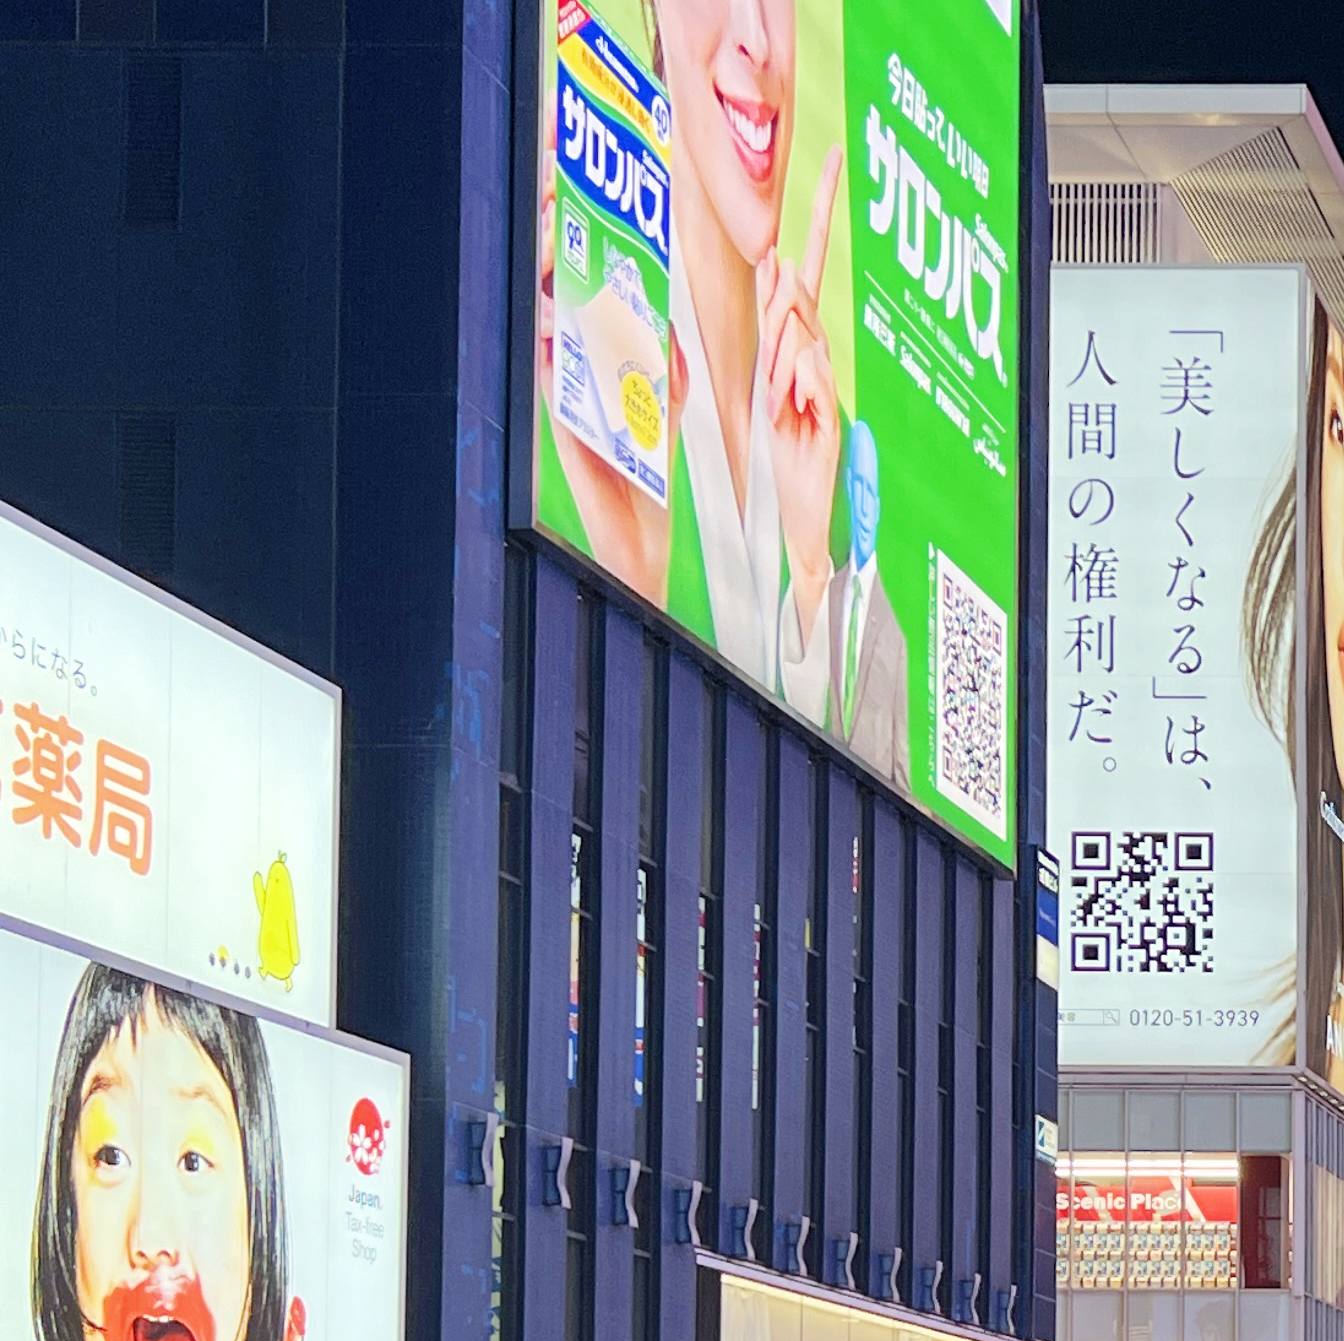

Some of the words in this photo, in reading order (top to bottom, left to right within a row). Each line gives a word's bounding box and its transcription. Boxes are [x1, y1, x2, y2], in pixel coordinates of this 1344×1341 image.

[563, 84, 668, 256] サロンパス
[866, 103, 1008, 388] サロンパス
[1064, 330, 1119, 774] 人間の権利だ。
[1151, 329, 1225, 791] 「美しくなる」は、
[0, 702, 153, 876] 薬局
[1129, 1009, 1260, 1028] 0120-51-3939
[345, 1211, 385, 1241] Tax-free
[348, 1183, 383, 1210] Japan.
[351, 1237, 377, 1266] Shop
